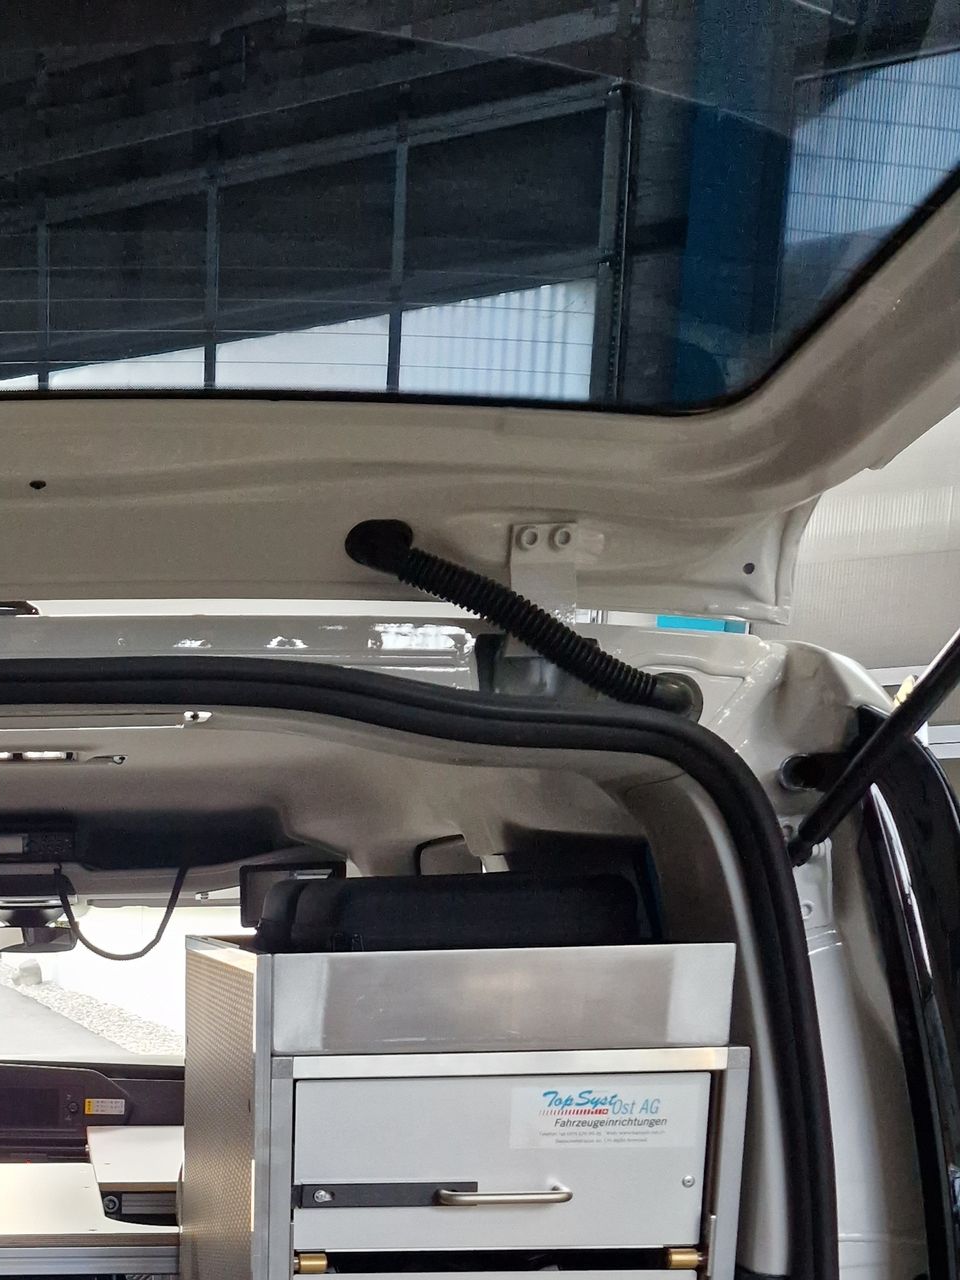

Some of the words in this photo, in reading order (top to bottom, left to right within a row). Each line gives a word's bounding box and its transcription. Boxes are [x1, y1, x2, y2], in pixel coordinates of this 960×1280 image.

[612, 1099, 636, 1115] Ost
[639, 1098, 661, 1115] AG
[554, 1117, 668, 1129] Fahrzeugeinrichtungen
